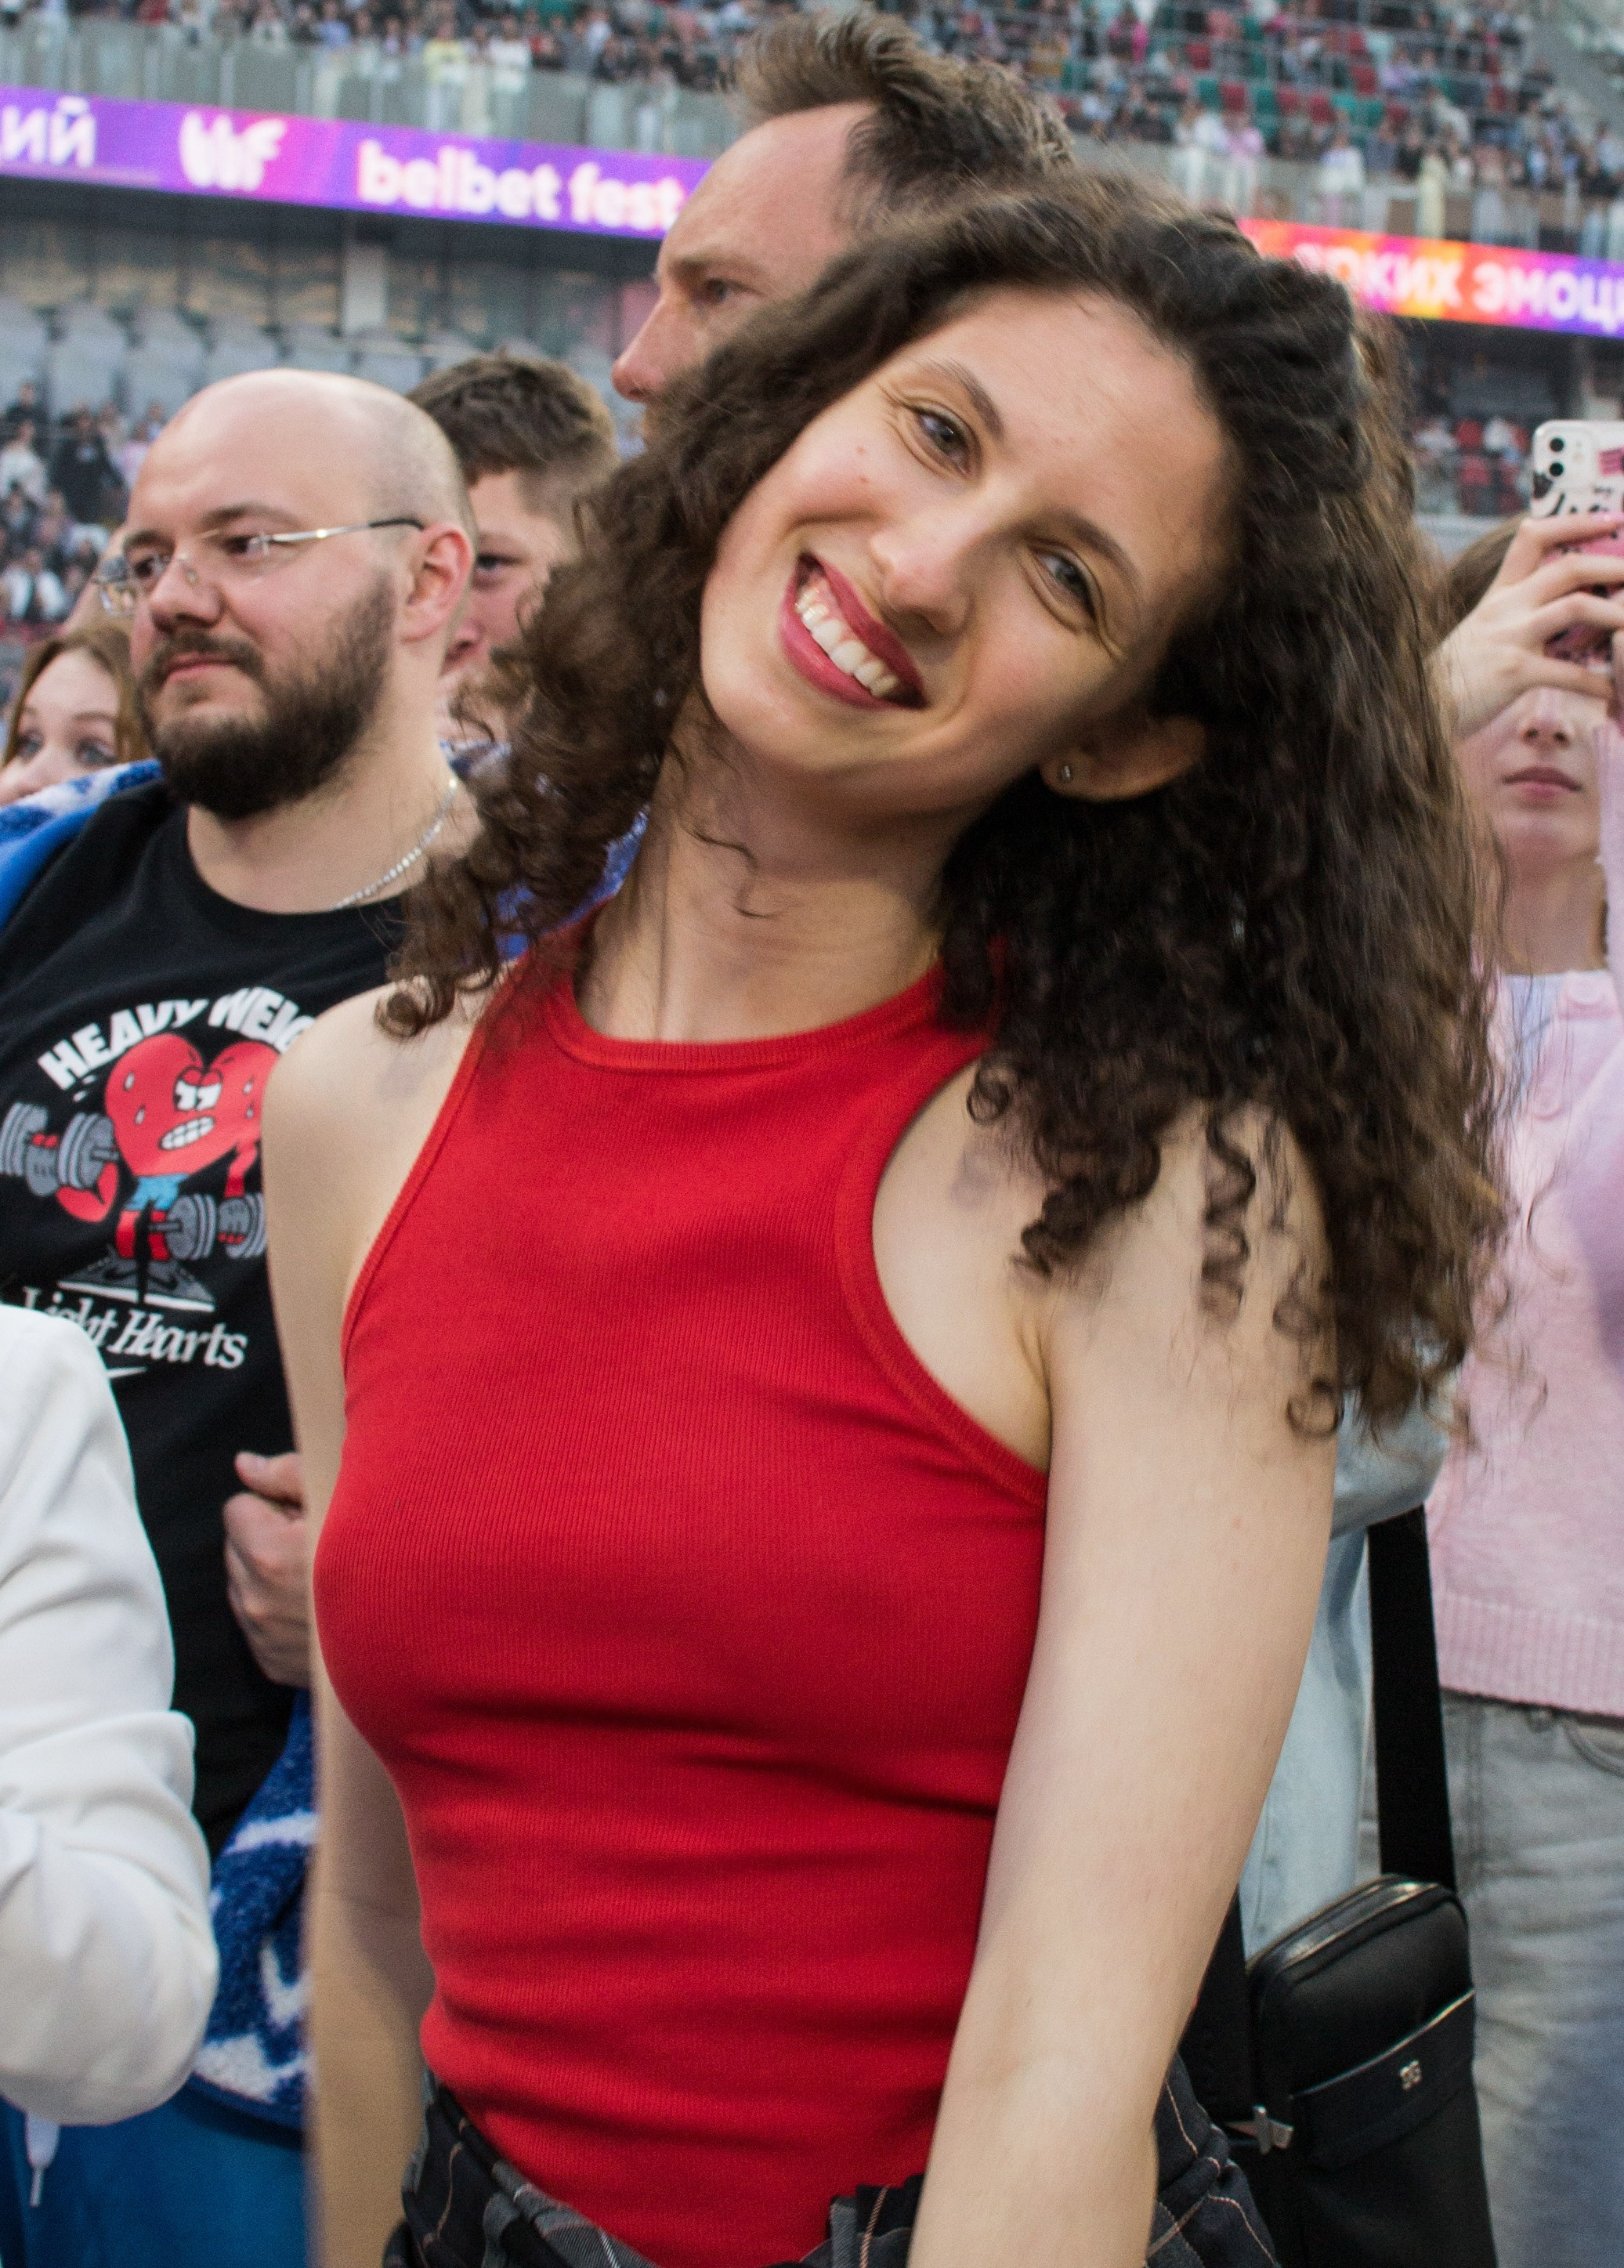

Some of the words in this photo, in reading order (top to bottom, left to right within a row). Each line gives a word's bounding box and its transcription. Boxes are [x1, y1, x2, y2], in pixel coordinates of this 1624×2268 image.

[358, 139, 562, 221] belbet
[568, 161, 685, 231] fest
[38, 998, 209, 1091] HEAVY
